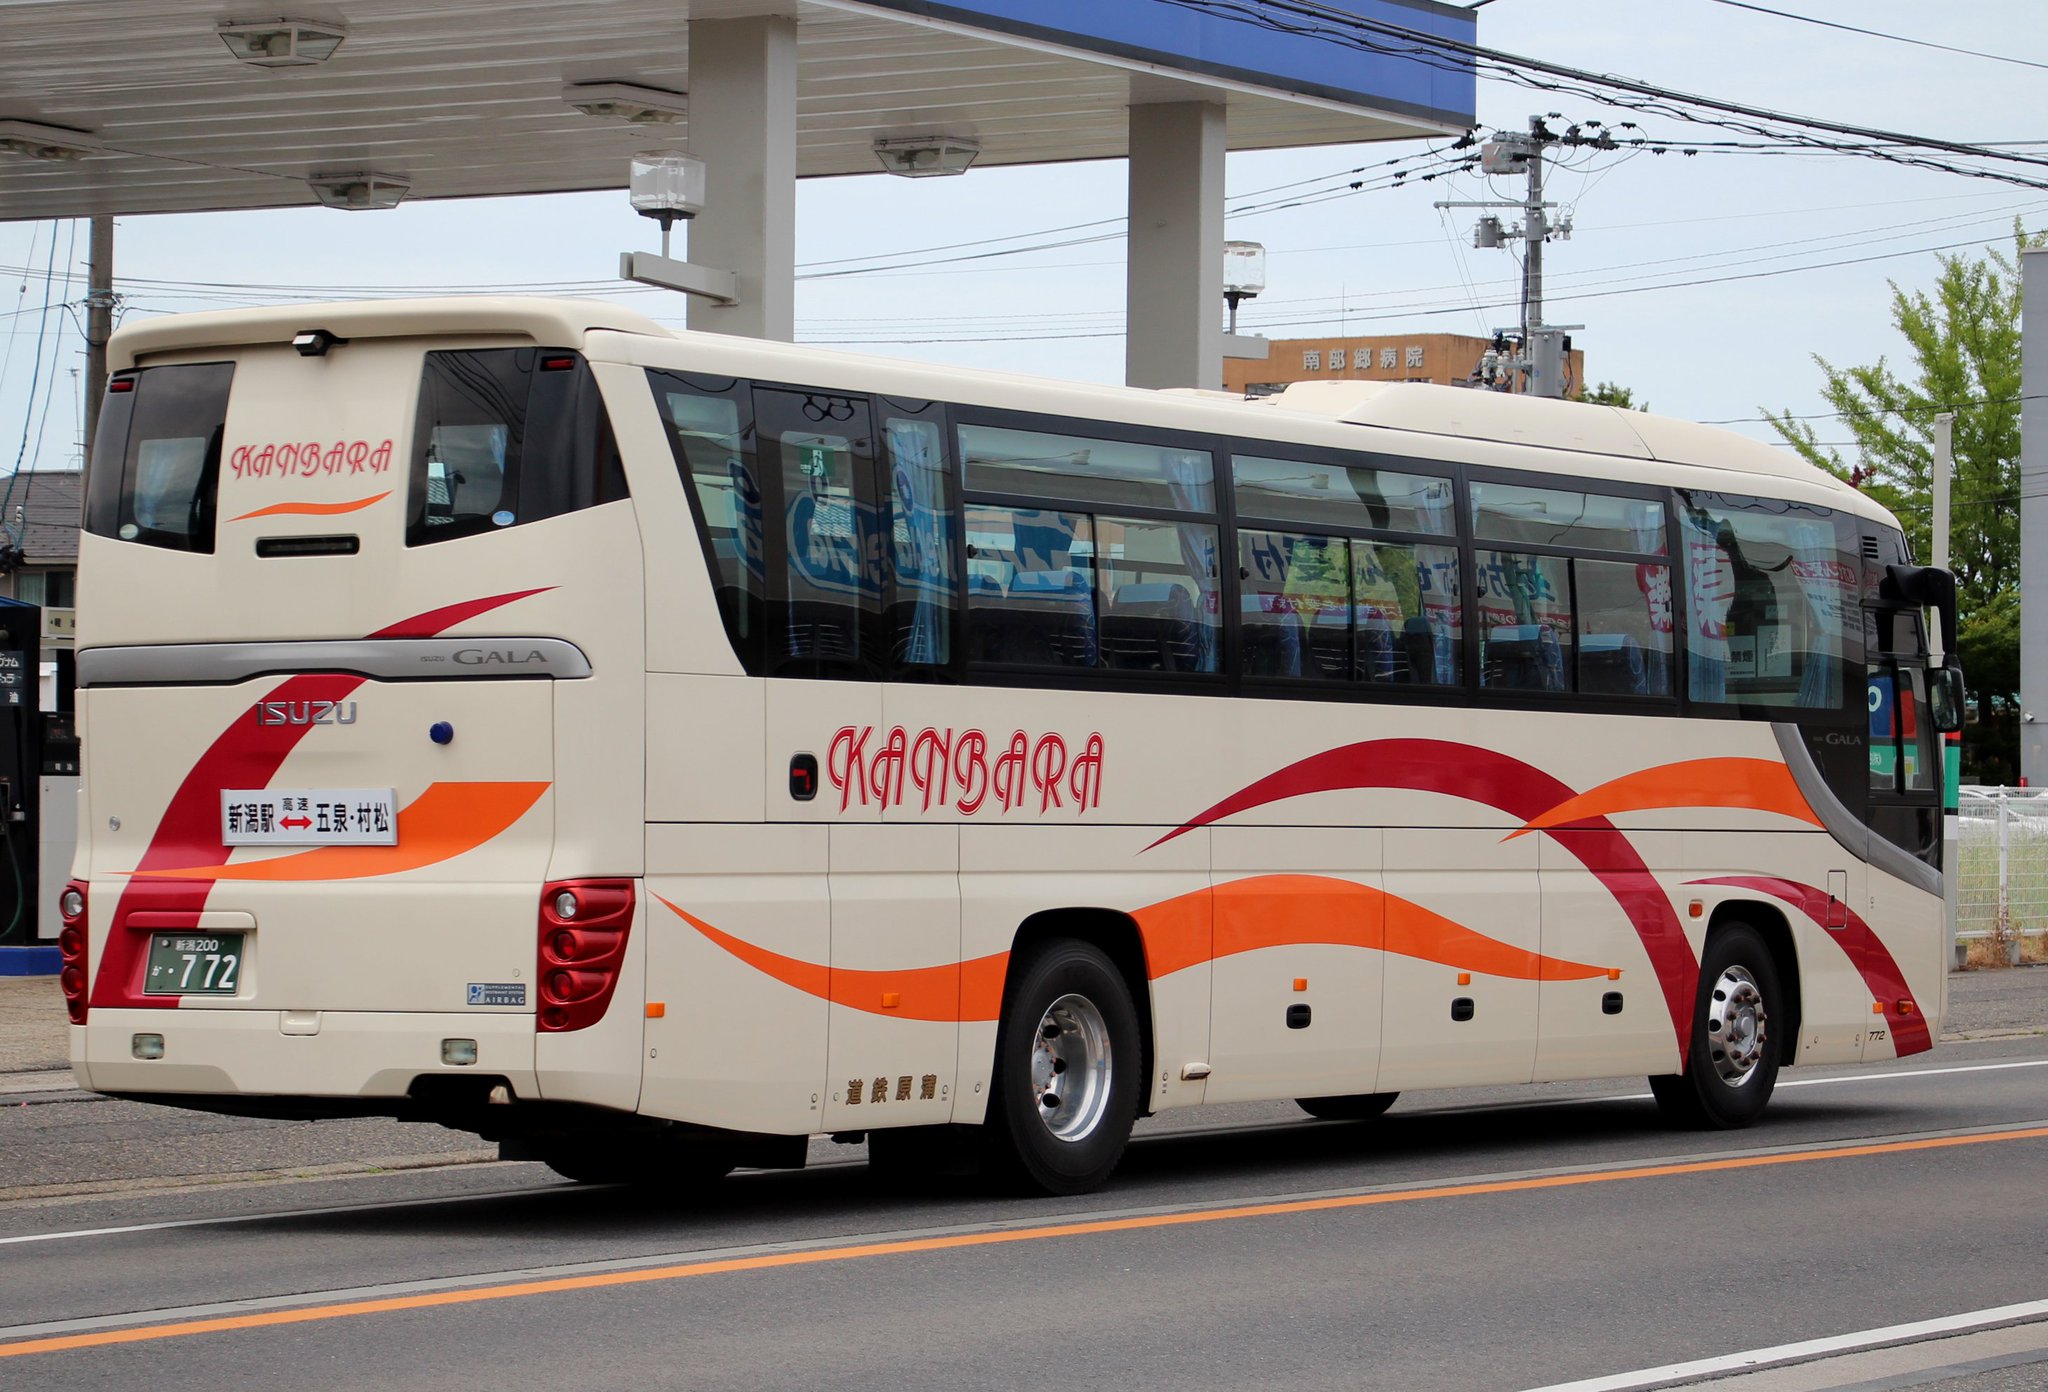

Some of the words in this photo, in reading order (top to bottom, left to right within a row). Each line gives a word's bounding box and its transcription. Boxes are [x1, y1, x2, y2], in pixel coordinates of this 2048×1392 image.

[1303, 346, 1423, 371] 南部郷病院
[231, 438, 394, 481] KANBARA
[452, 648, 549, 665] GALA
[256, 701, 357, 725] ISUZU
[1825, 732, 1862, 745] GALA
[826, 725, 1106, 816] KANBARA
[282, 797, 309, 811] 高速
[228, 803, 275, 833] 新潟駅
[485, 996, 525, 1004] AIRBAG
[1869, 1030, 1885, 1041] 772
